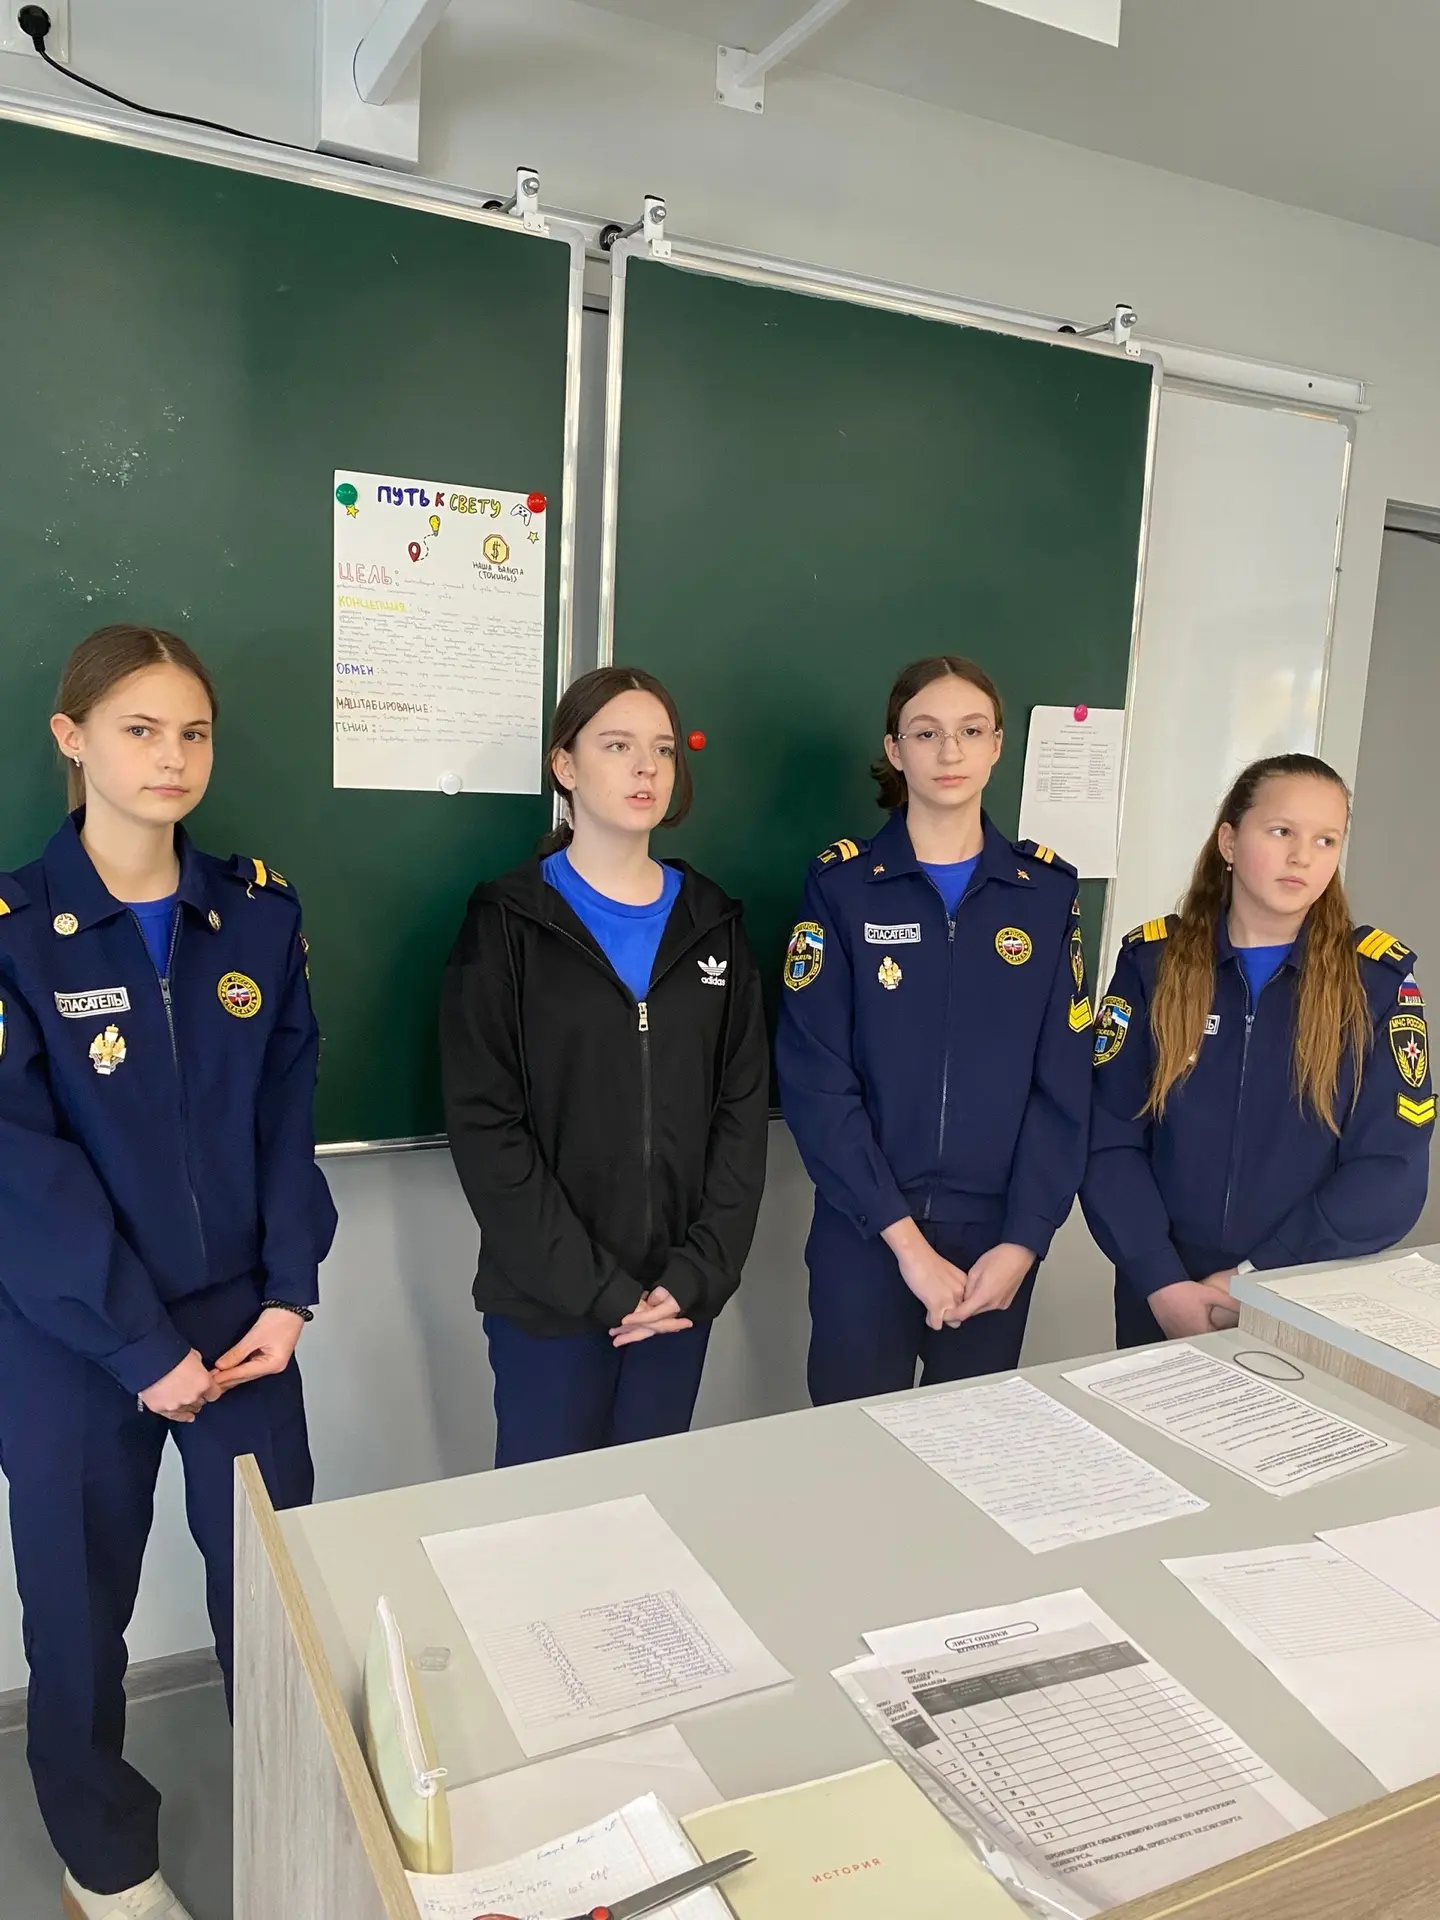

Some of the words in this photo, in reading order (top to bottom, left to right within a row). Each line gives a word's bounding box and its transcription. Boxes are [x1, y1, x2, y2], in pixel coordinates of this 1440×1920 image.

[377, 485, 431, 507] ПУТЬ
[434, 491, 446, 507] К
[449, 493, 502, 519] СВЕТУ
[472, 560, 493, 571] НАША
[867, 927, 918, 940] СПАСАТЕЛЬ
[700, 975, 726, 987] adidas
[58, 993, 124, 1013] СПАСАТЕЛЬ
[1391, 1018, 1406, 1029] МЧС
[1024, 1810, 1037, 1818] 10
[1034, 1820, 1045, 1829] 11
[1043, 1831, 1055, 1840] 12
[811, 1857, 881, 1884] ИСТОРИЯ
